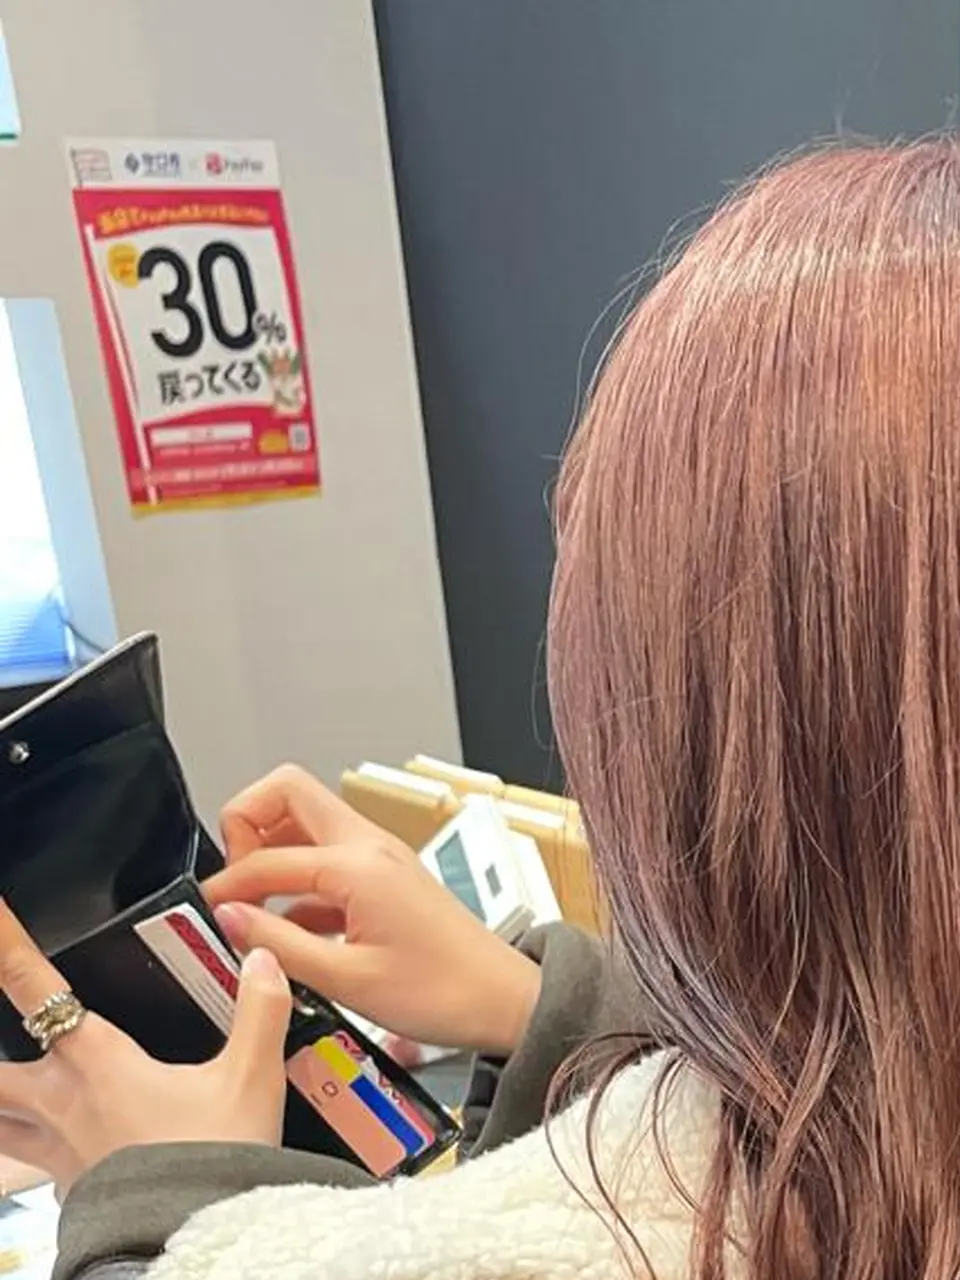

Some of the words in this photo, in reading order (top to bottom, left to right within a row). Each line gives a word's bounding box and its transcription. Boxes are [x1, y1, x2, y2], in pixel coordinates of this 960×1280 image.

[157, 361, 262, 405] 戻ってくる
